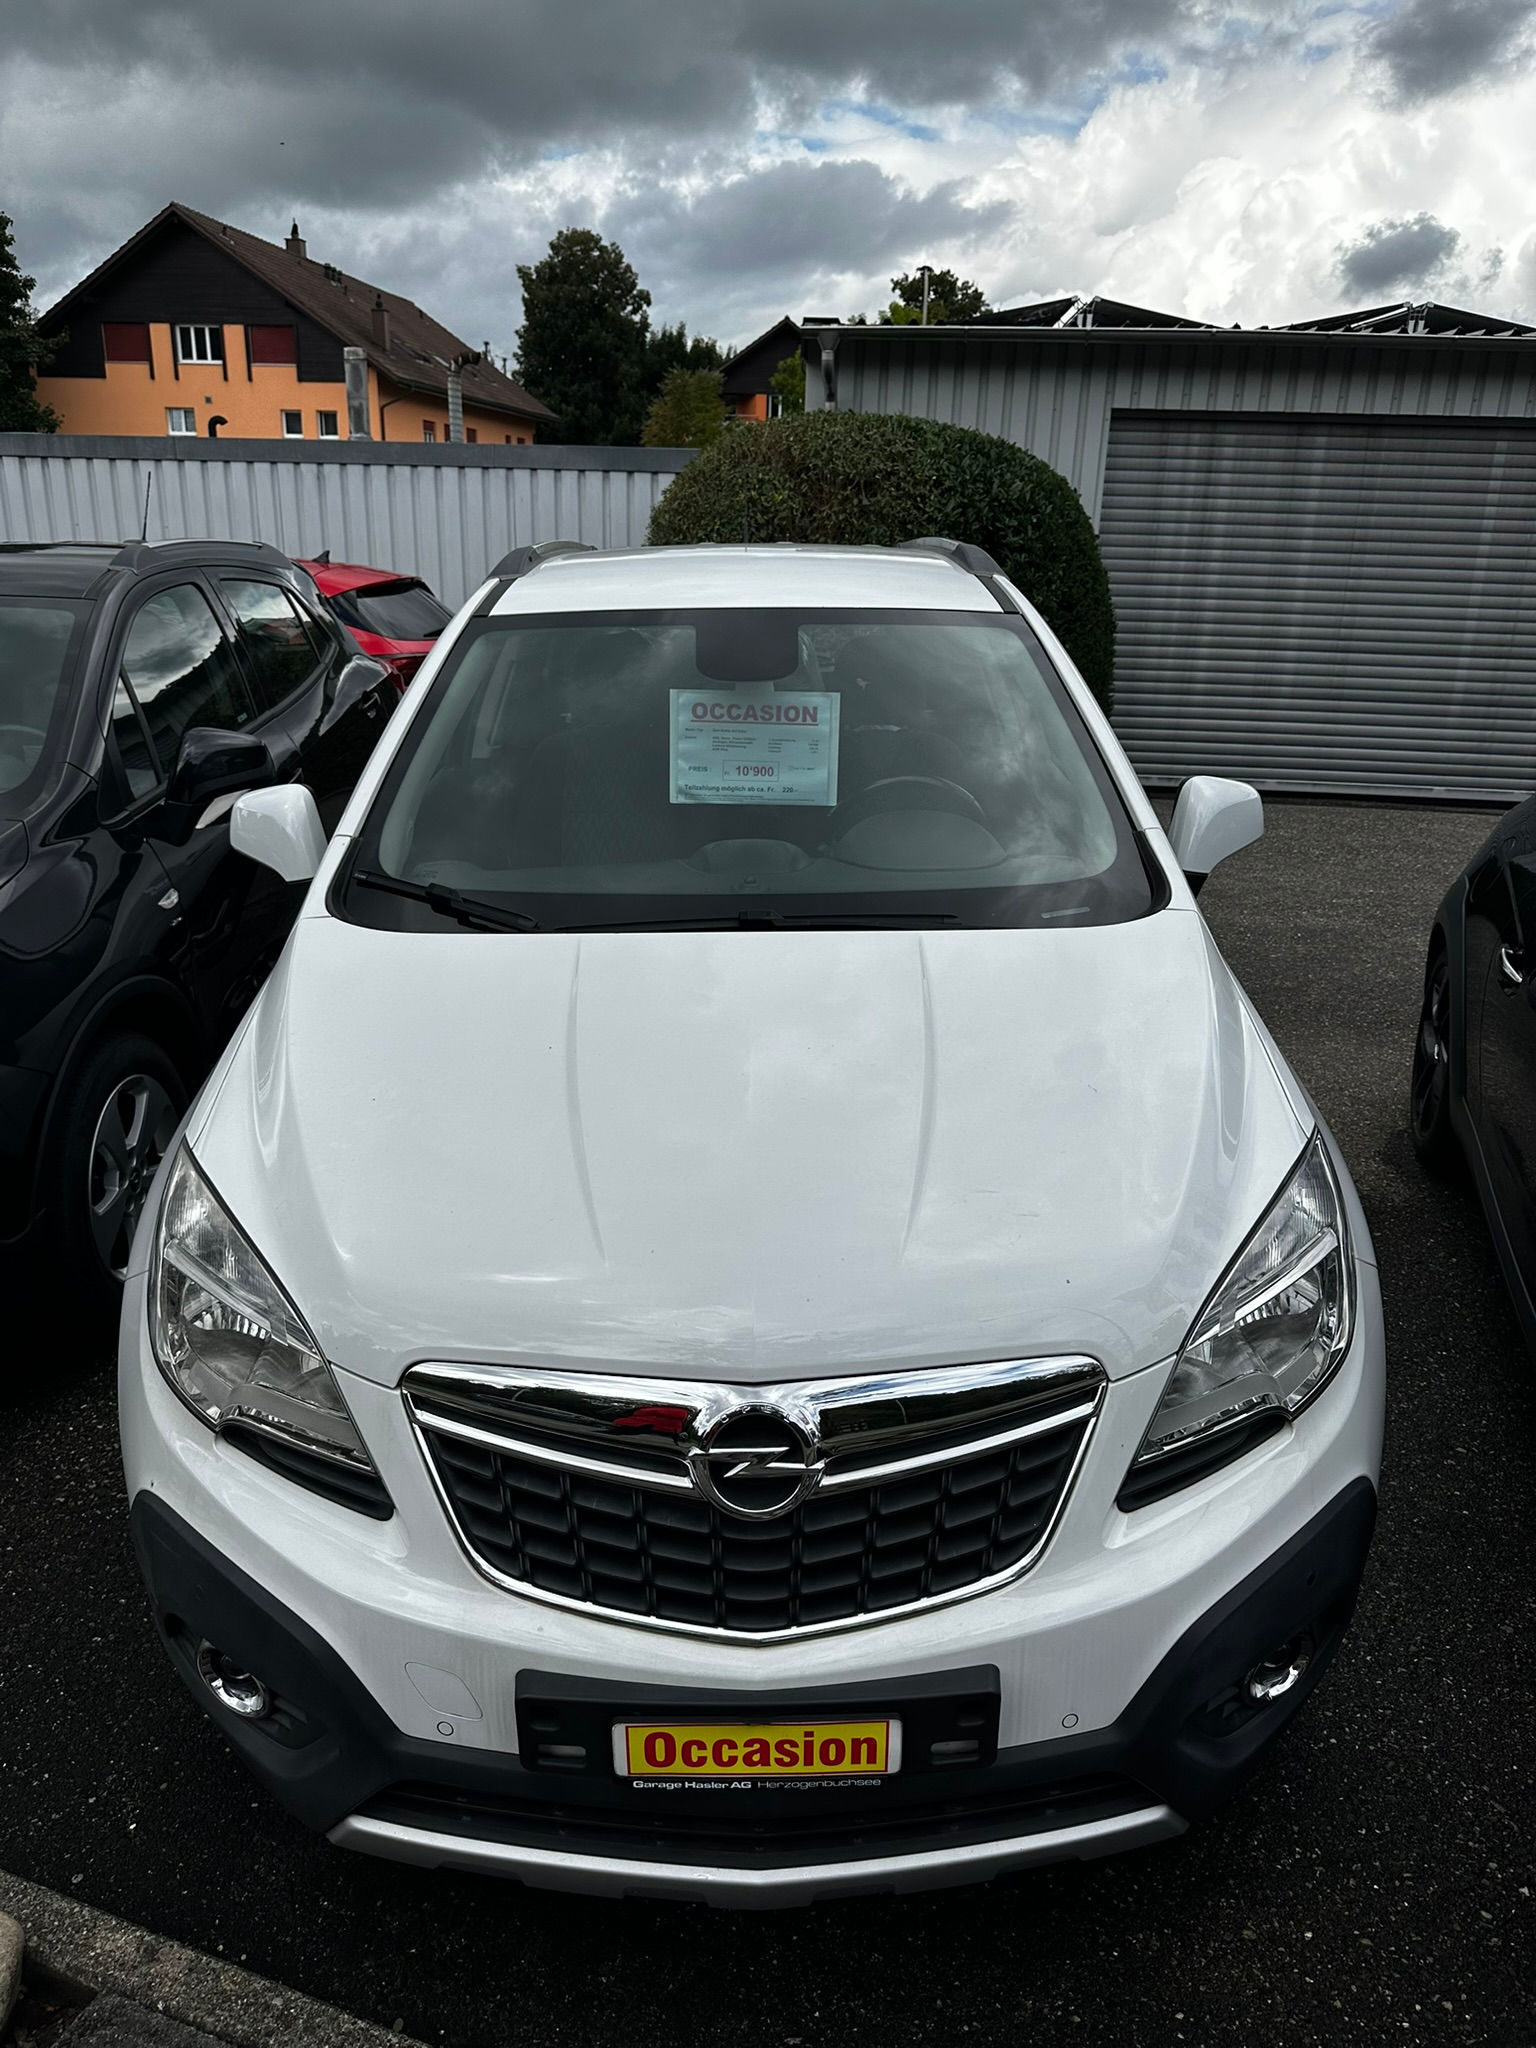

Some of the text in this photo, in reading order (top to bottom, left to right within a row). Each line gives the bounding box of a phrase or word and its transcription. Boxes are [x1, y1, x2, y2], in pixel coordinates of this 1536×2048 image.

[691, 702, 818, 722] OCCASION
[685, 784, 720, 793] Teilzahlung
[721, 785, 746, 793] möglich
[643, 1731, 877, 1768] Occasion
[632, 1779, 881, 1790] Garage Hasler AG Herzogenbuchsee
